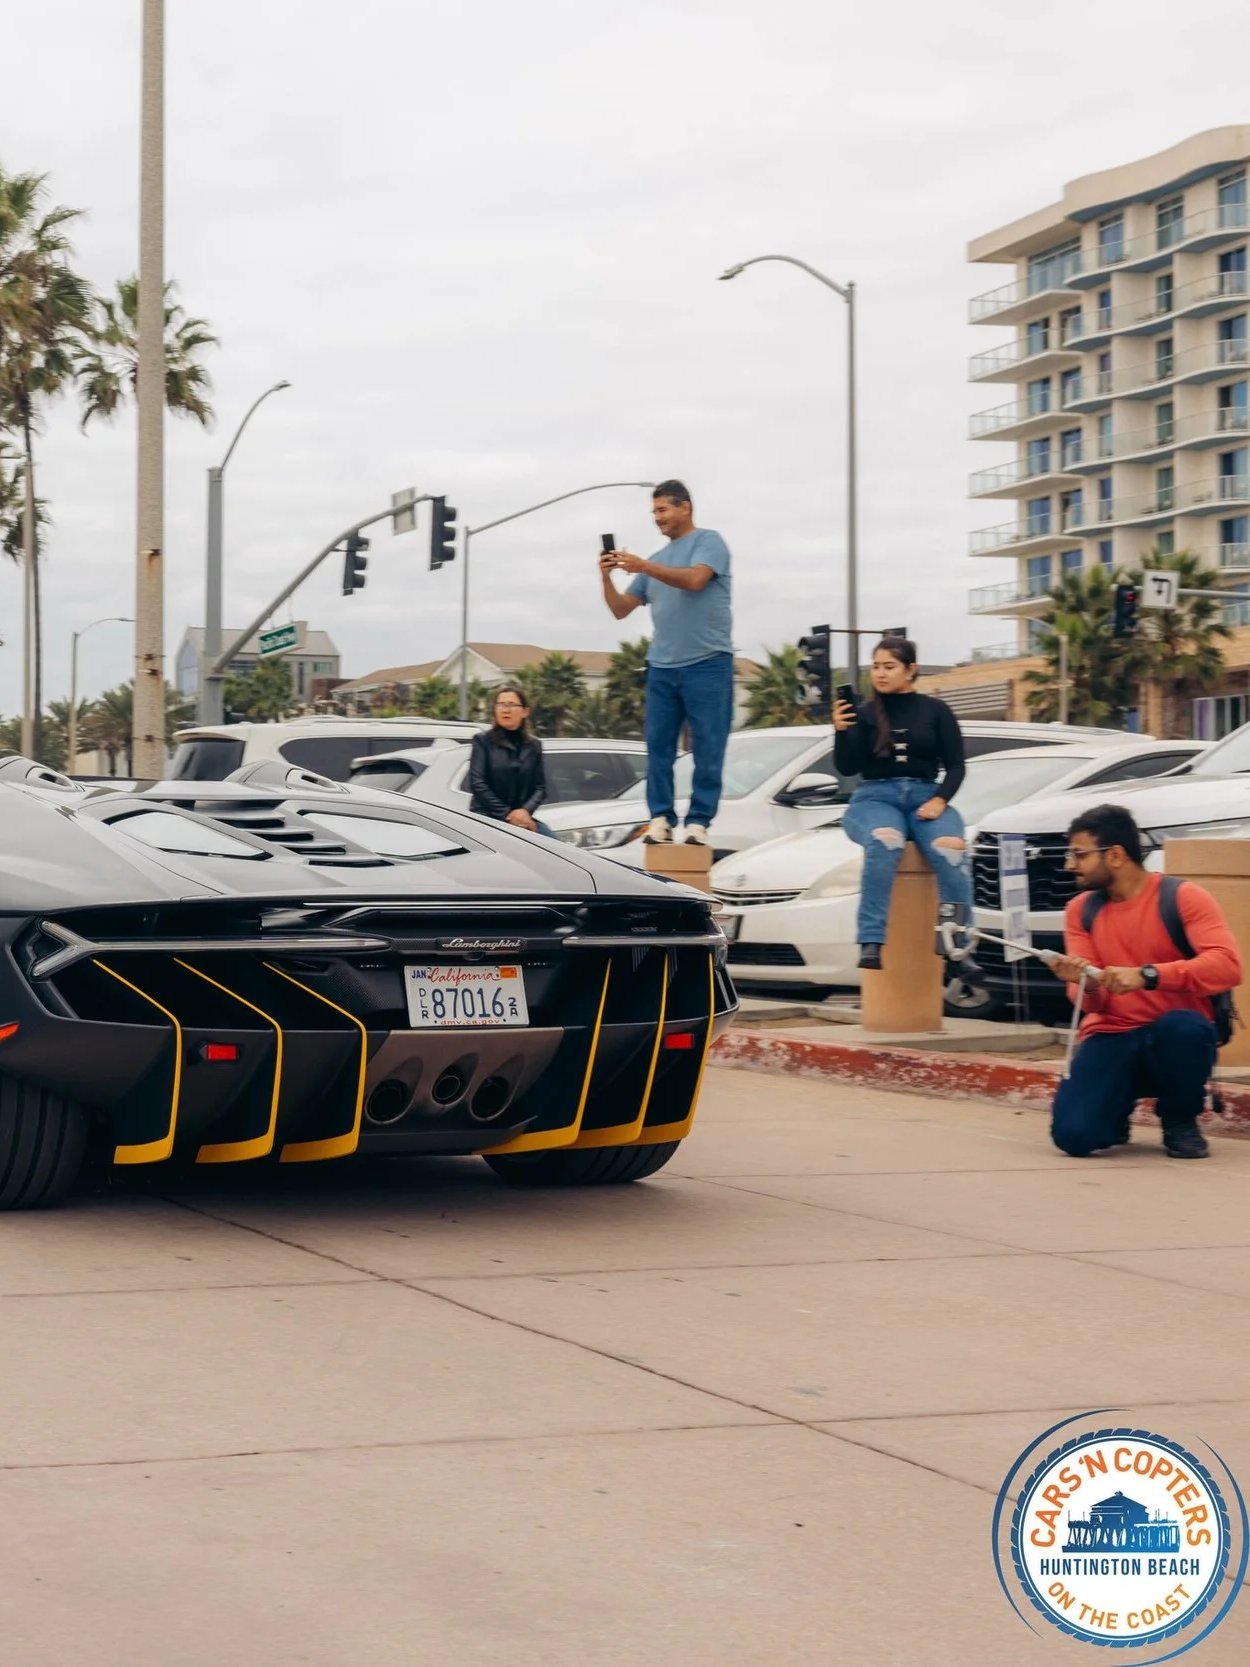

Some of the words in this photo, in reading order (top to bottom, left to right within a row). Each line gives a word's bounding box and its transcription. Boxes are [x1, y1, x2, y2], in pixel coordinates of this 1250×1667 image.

[442, 938, 521, 950] Lamborghini
[411, 969, 427, 979] JAN
[430, 967, 501, 986] California
[431, 987, 505, 1019] 87016
